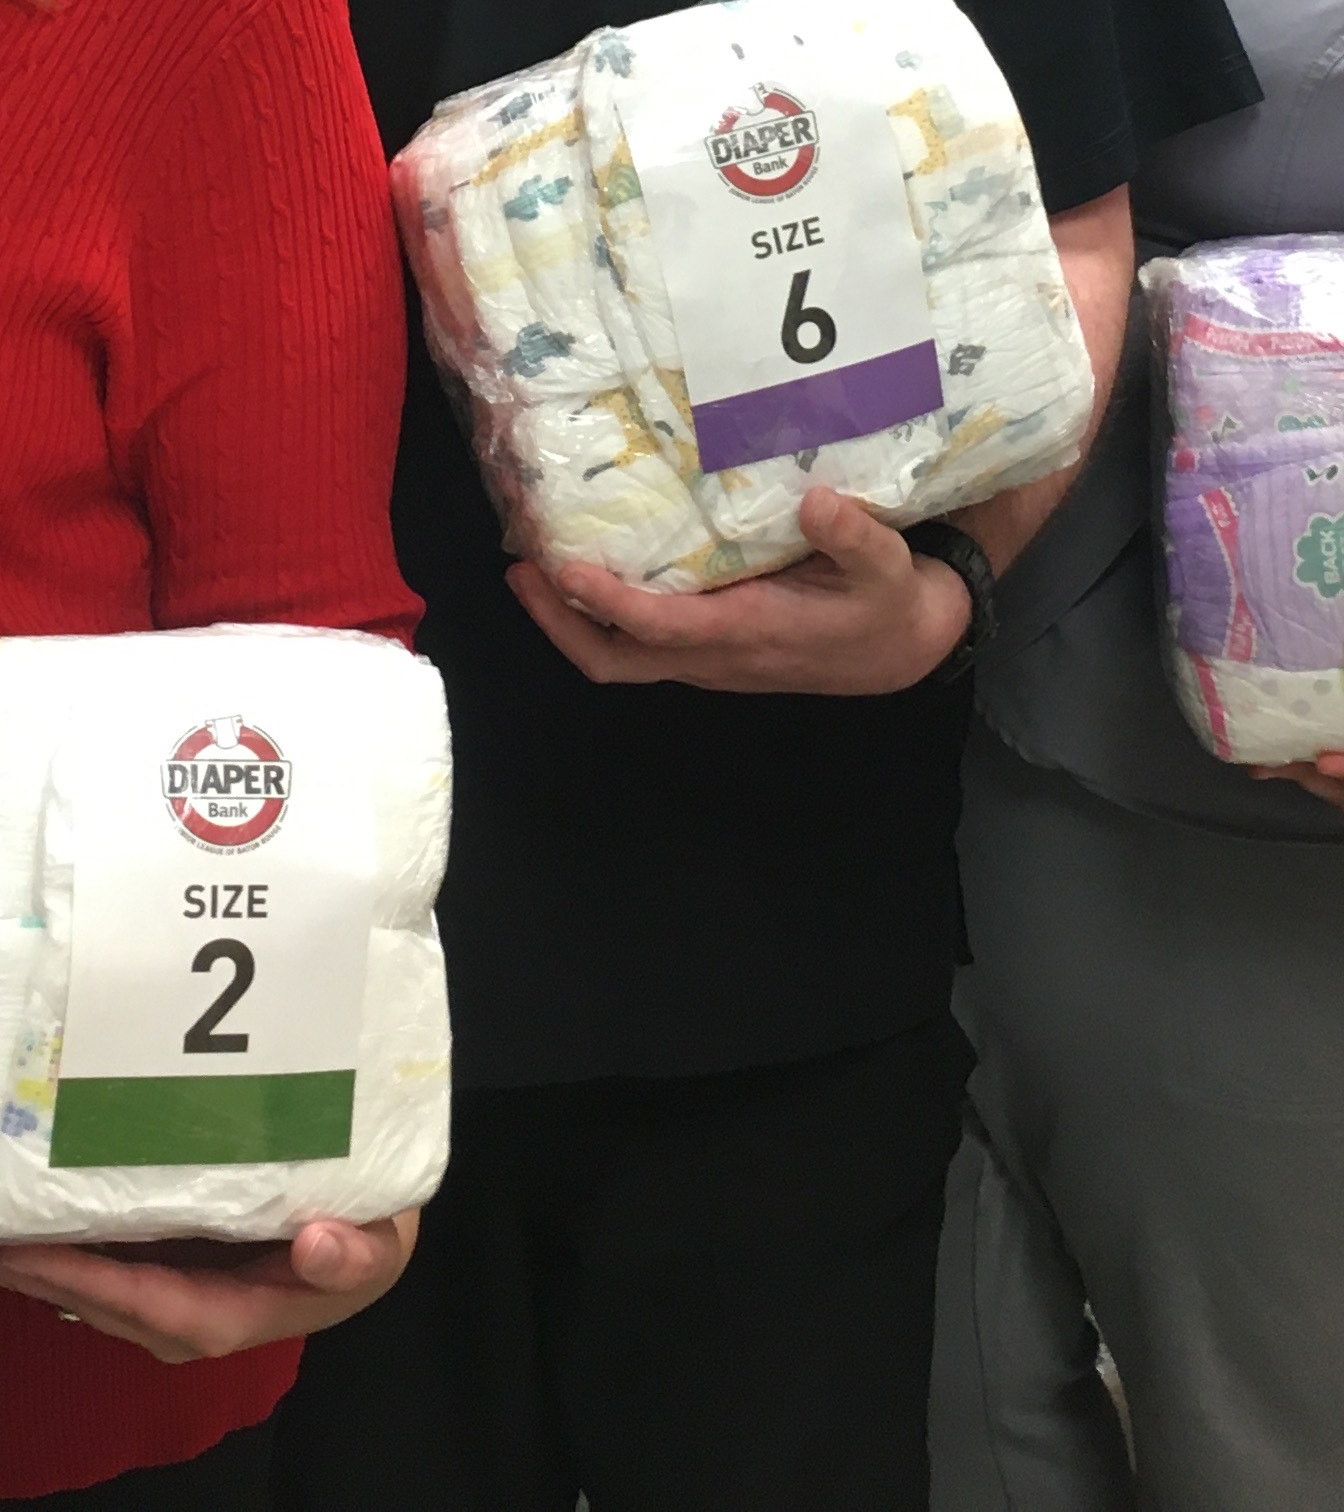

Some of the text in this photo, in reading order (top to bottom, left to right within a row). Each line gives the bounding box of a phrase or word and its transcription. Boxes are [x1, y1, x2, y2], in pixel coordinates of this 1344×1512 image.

[712, 116, 815, 165] DIAPER
[752, 155, 788, 176] Bank
[750, 216, 825, 260] SIZE
[781, 268, 838, 365] 6
[1319, 530, 1341, 585] BACK
[167, 763, 286, 796] DIAPER
[207, 802, 249, 819] Bank
[182, 884, 269, 920] SIZE
[182, 937, 256, 1054] 2
